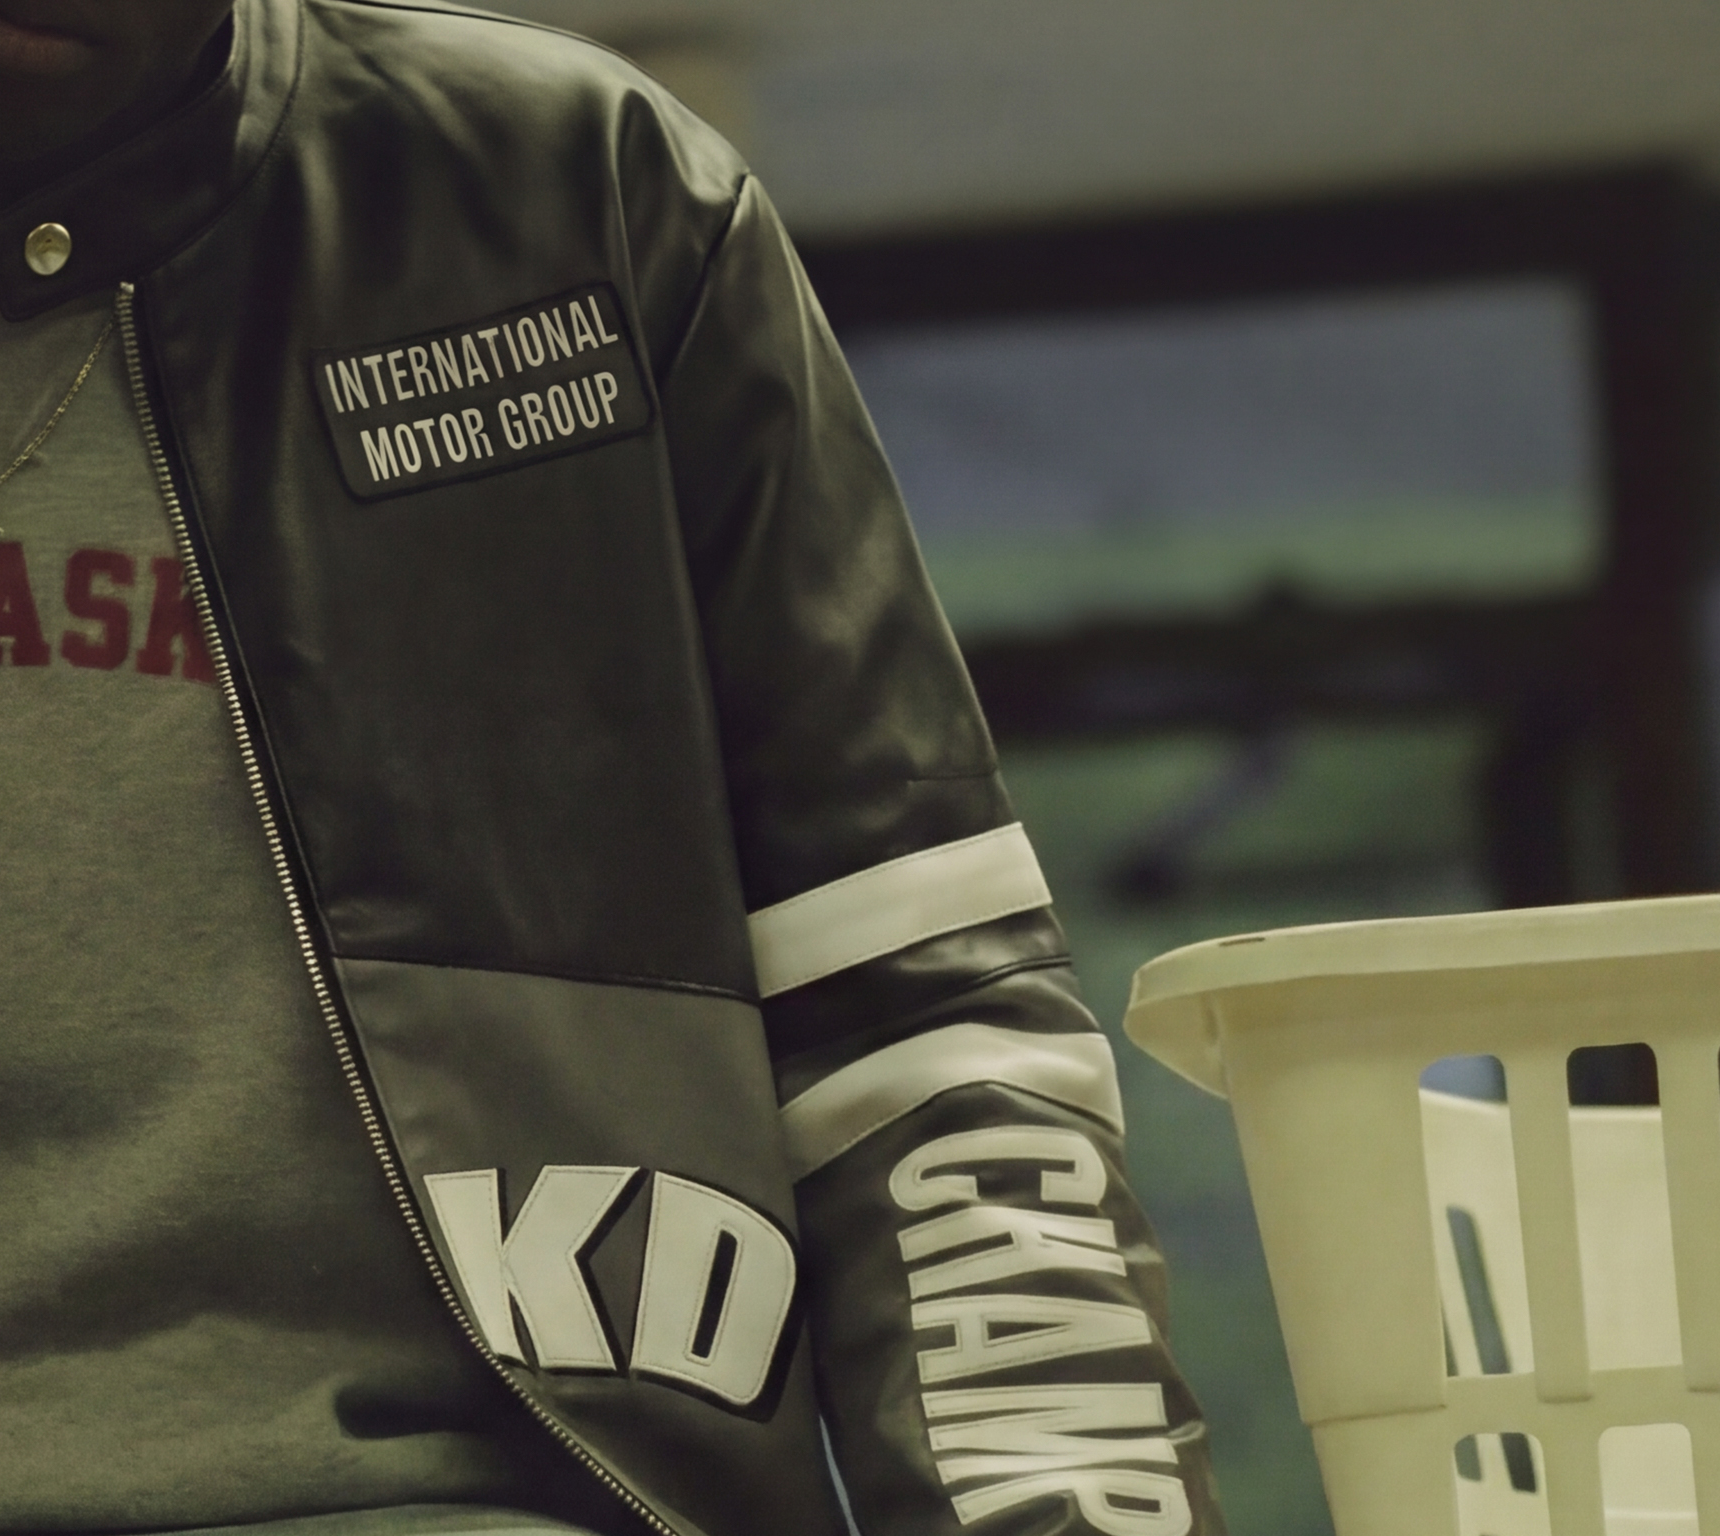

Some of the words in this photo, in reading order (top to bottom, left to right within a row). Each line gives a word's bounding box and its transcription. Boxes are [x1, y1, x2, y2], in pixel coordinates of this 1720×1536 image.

[325, 295, 618, 413] INTERNATIONAL
[360, 408, 494, 482] MOTOR
[498, 371, 618, 450] GROUP
[423, 1164, 797, 1407] KD
